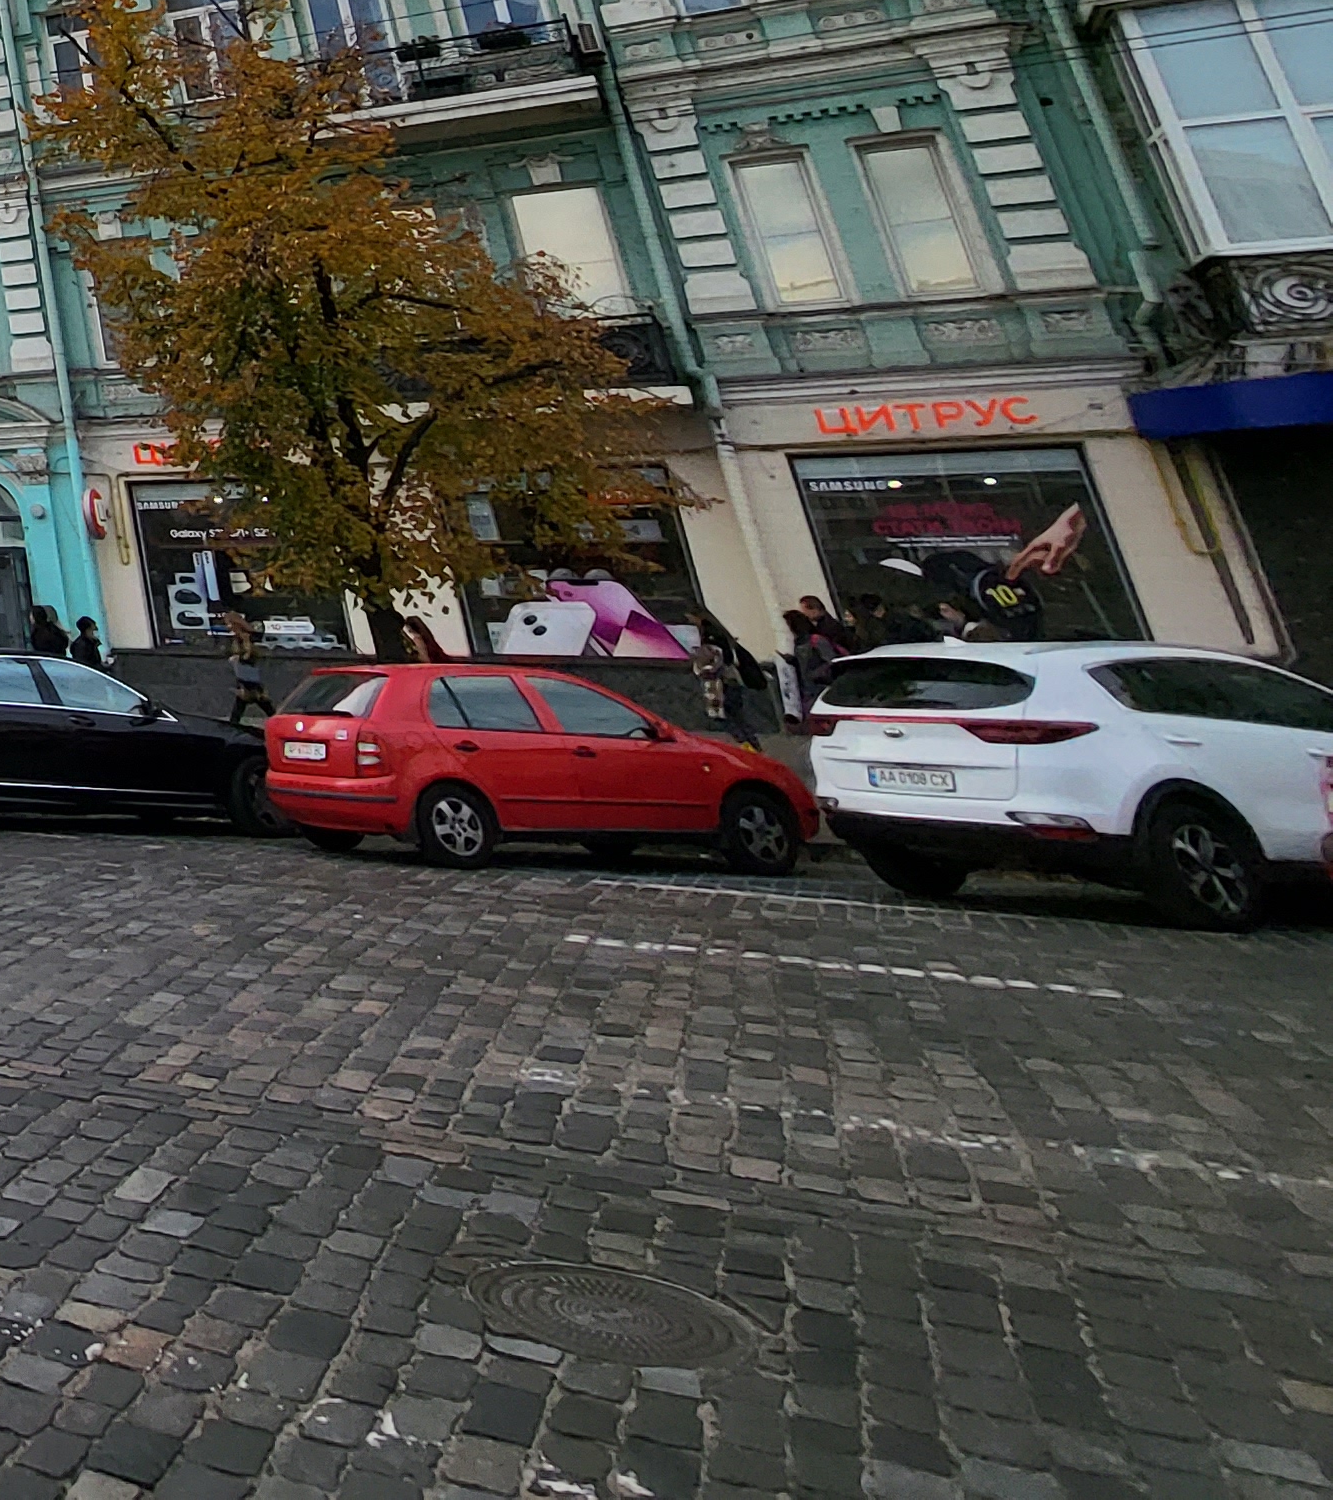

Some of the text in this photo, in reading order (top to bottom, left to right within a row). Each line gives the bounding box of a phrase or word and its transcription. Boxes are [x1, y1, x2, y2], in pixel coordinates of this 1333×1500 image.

[814, 396, 1038, 436] ЦИТРУС
[809, 480, 886, 492] SAMSUNG
[170, 529, 207, 540] Galaxy
